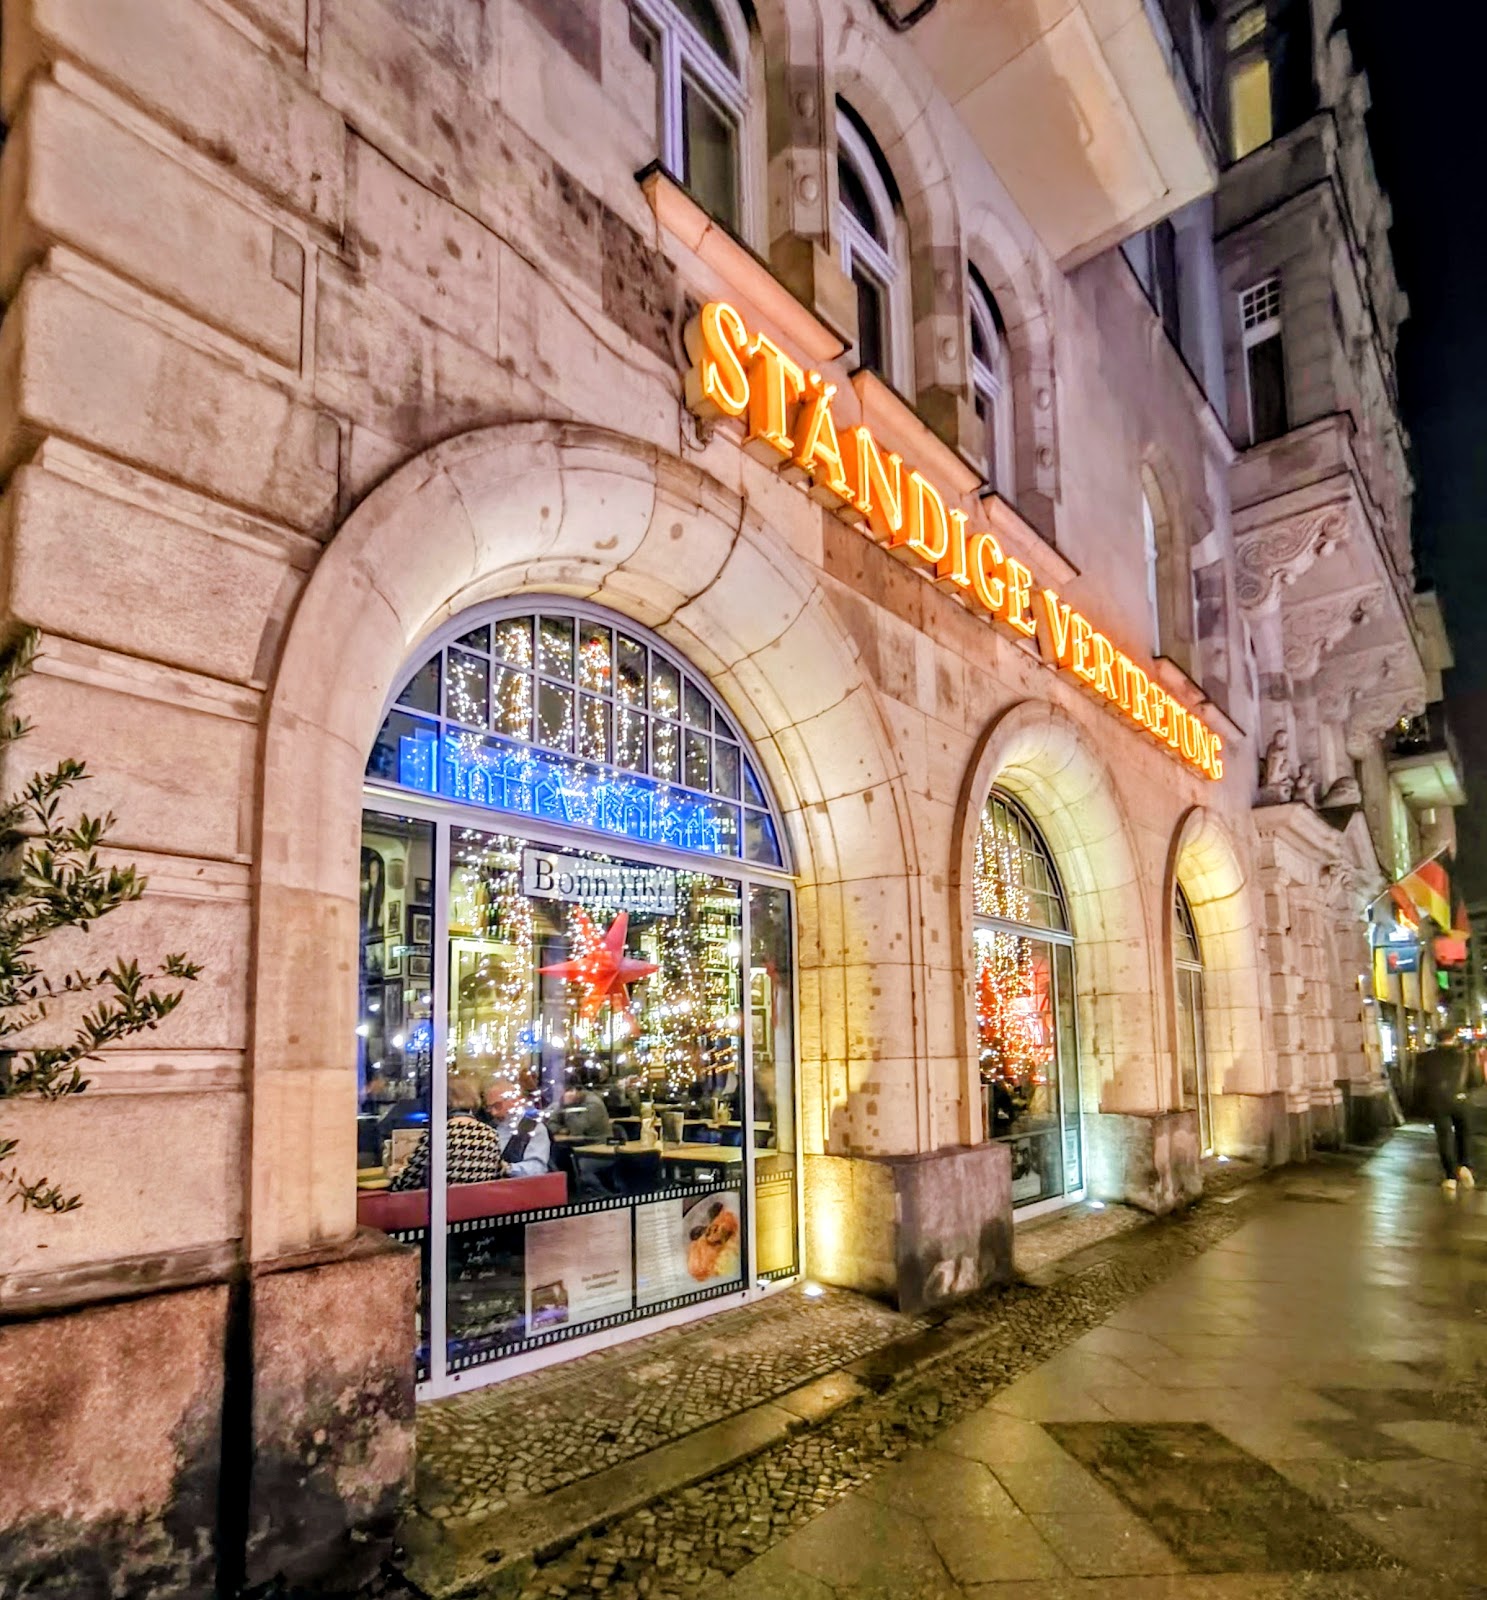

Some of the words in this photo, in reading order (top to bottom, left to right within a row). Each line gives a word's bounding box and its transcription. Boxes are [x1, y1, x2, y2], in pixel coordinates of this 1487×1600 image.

[699, 301, 1038, 637] STÄNDIGE
[1041, 587, 1224, 781] VERTRETUNG
[534, 857, 608, 897] Bonn
